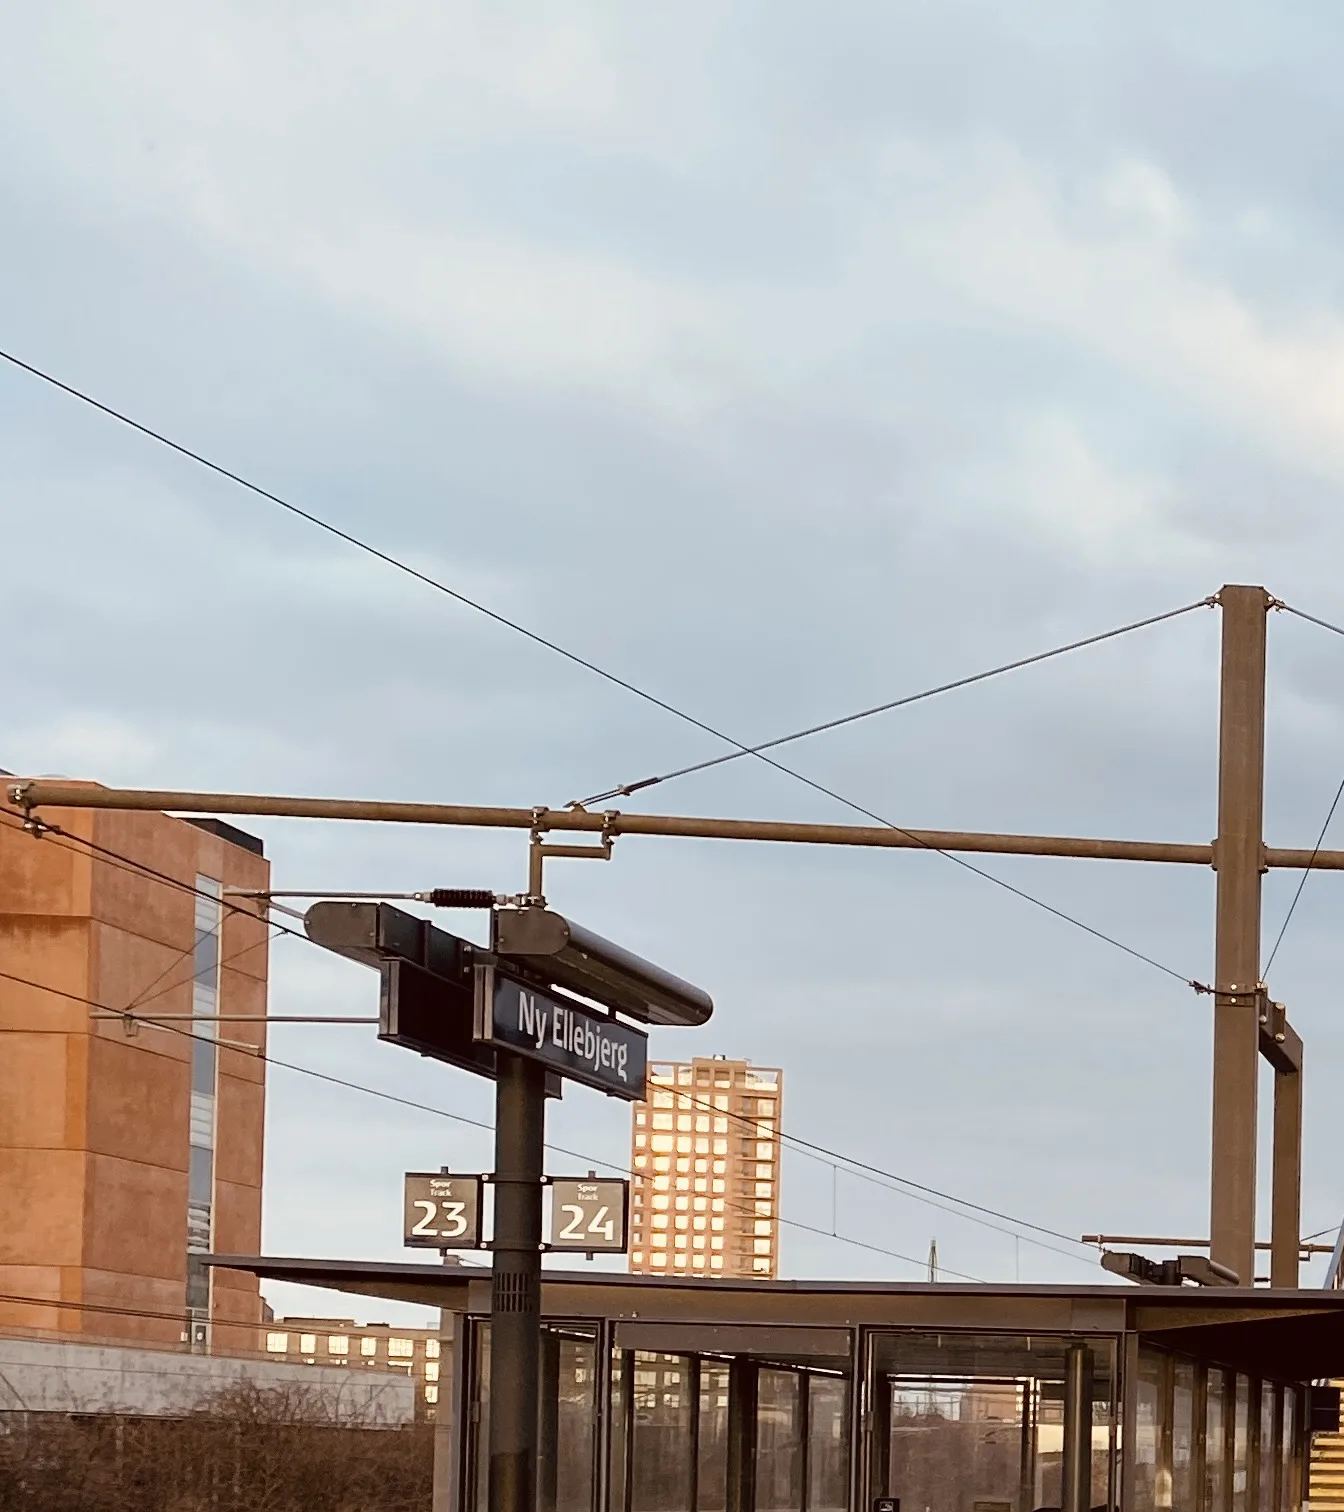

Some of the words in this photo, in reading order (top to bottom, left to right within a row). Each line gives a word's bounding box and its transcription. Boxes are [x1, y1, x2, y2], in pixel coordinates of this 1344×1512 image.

[518, 991, 547, 1049] Ny
[552, 1006, 628, 1083] Ellebjerg
[430, 1179, 452, 1189] Spor
[577, 1183, 599, 1193] Spor
[430, 1188, 453, 1197] Track
[577, 1192, 599, 1201] Track
[411, 1200, 468, 1237] 23
[559, 1204, 614, 1241] 24
